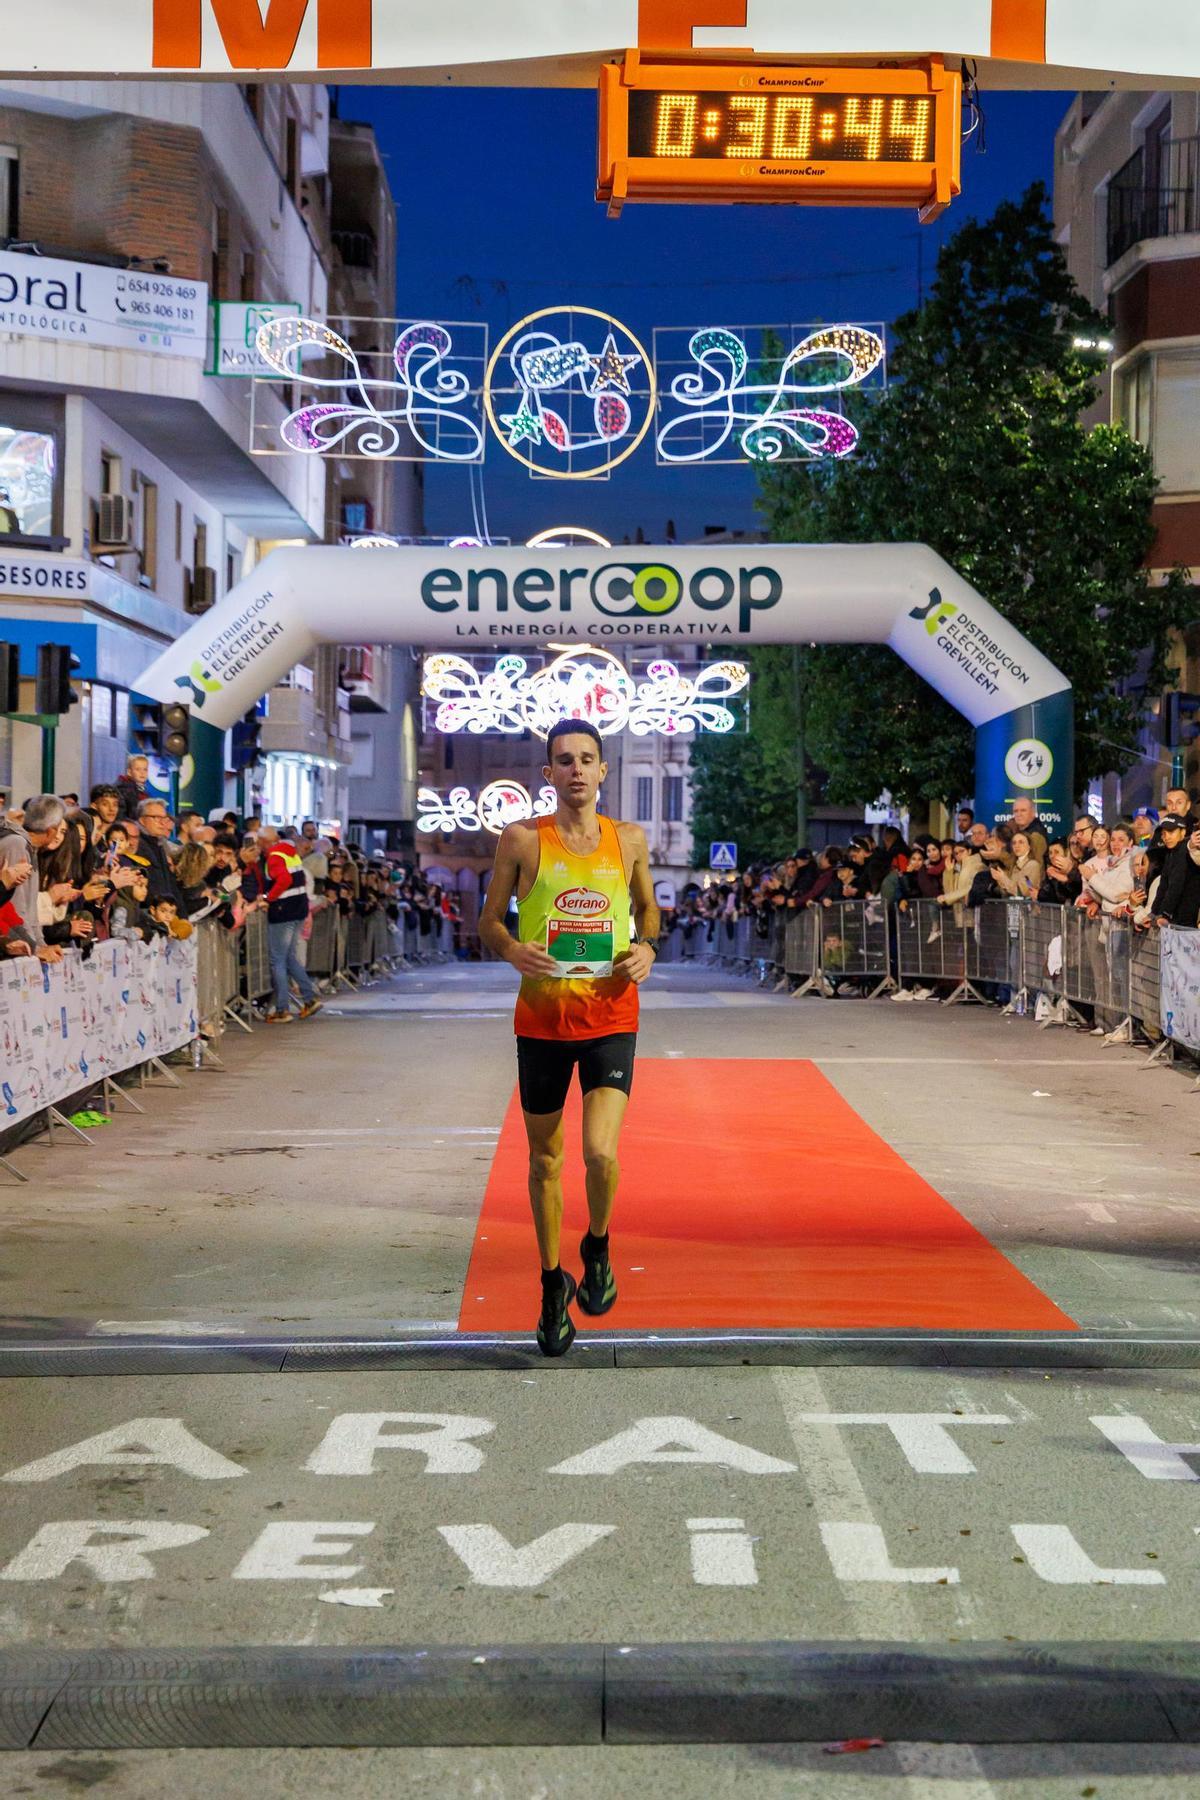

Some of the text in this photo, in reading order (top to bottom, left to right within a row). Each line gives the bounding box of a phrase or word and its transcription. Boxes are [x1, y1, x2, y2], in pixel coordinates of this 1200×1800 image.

[655, 95, 930, 160] 0:30:44
[128, 279, 197, 300] 654 926 469
[130, 301, 195, 320] 965 406 181
[0, 565, 87, 589] SESORES
[420, 563, 783, 633] enercoop
[202, 590, 274, 661] DISTRIBUCIÓN
[456, 621, 732, 636] LA ENERGÍA COOPERATIVA
[223, 621, 285, 681] CREVILLENT
[937, 635, 1000, 696] CREVILLENT
[957, 613, 1030, 685] DISTRIBUCIÓN
[559, 896, 606, 909] Serrano
[575, 939, 587, 956] 3
